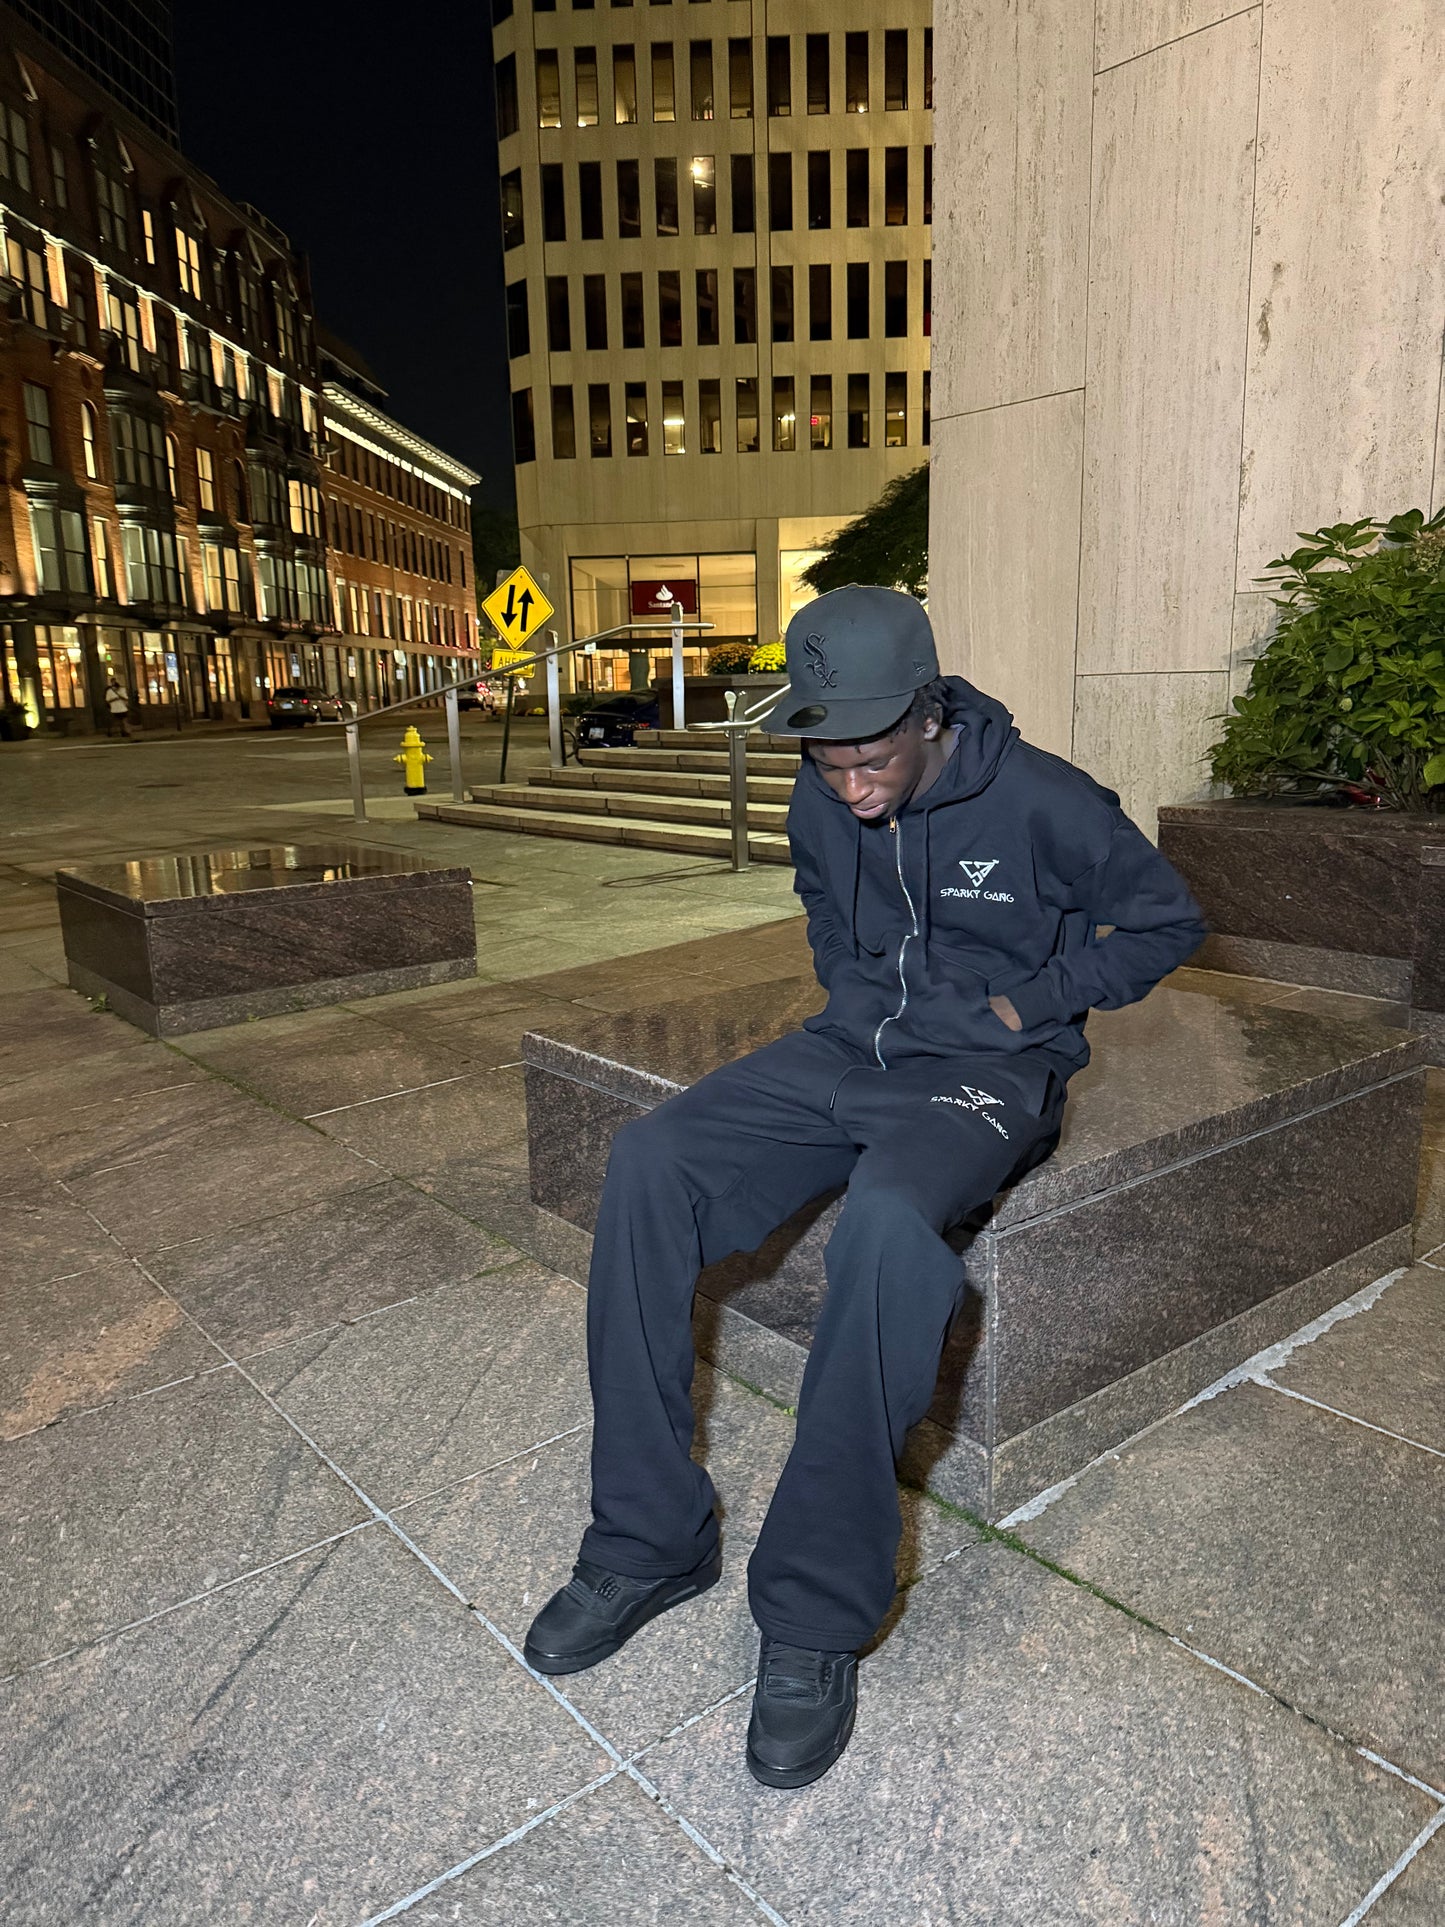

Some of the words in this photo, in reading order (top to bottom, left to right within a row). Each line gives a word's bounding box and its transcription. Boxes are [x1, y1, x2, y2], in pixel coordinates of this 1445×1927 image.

[940, 887, 981, 899] SPARKY
[983, 891, 1015, 903] GANG
[930, 1096, 980, 1111] SPARKY
[982, 1111, 1009, 1140] GANG
